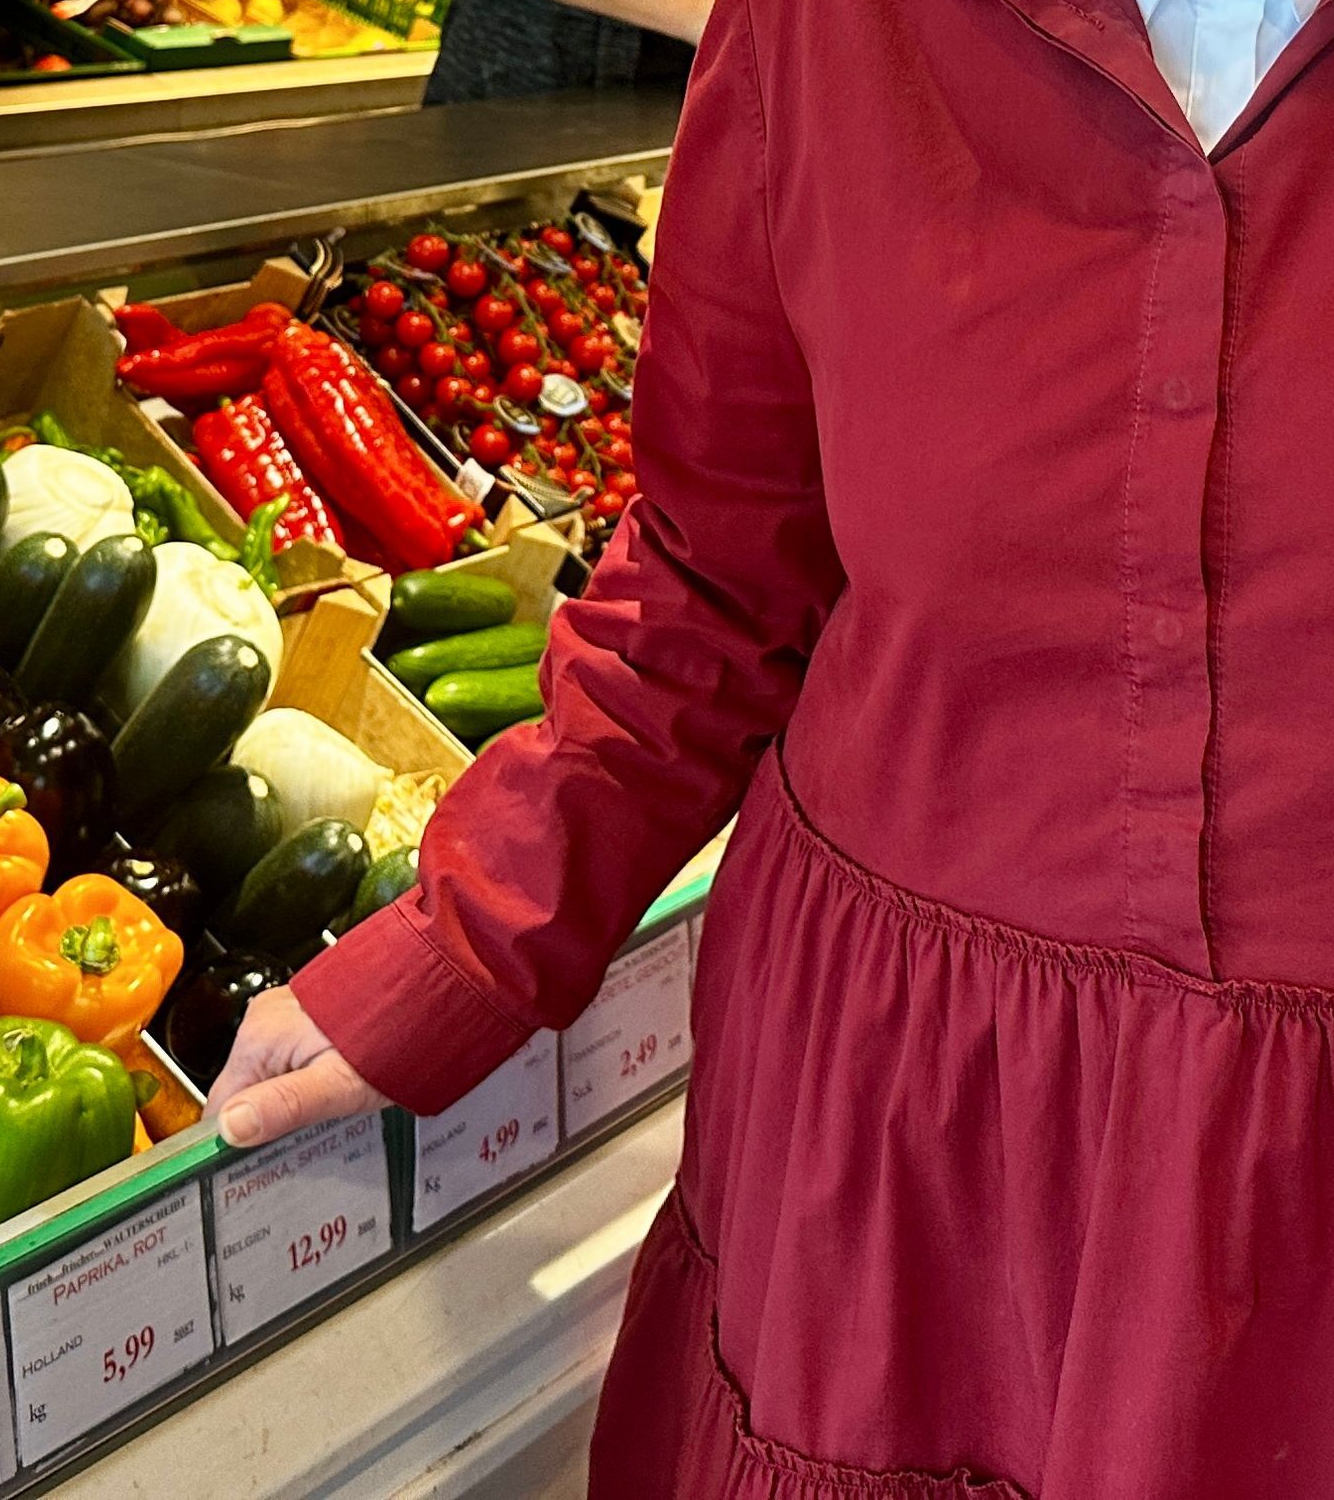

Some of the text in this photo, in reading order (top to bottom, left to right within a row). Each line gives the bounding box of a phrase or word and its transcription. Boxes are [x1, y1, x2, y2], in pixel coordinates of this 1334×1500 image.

[345, 1113, 376, 1142] ROT
[479, 1118, 521, 1164] 4,99
[53, 1226, 167, 1306] PAPRIKA, ROT
[223, 1225, 271, 1261] BELGIEN
[288, 1214, 348, 1272] 12,99
[22, 1334, 84, 1380] HOLLAND
[103, 1325, 156, 1383] 5,99
[29, 1403, 48, 1424] kg
